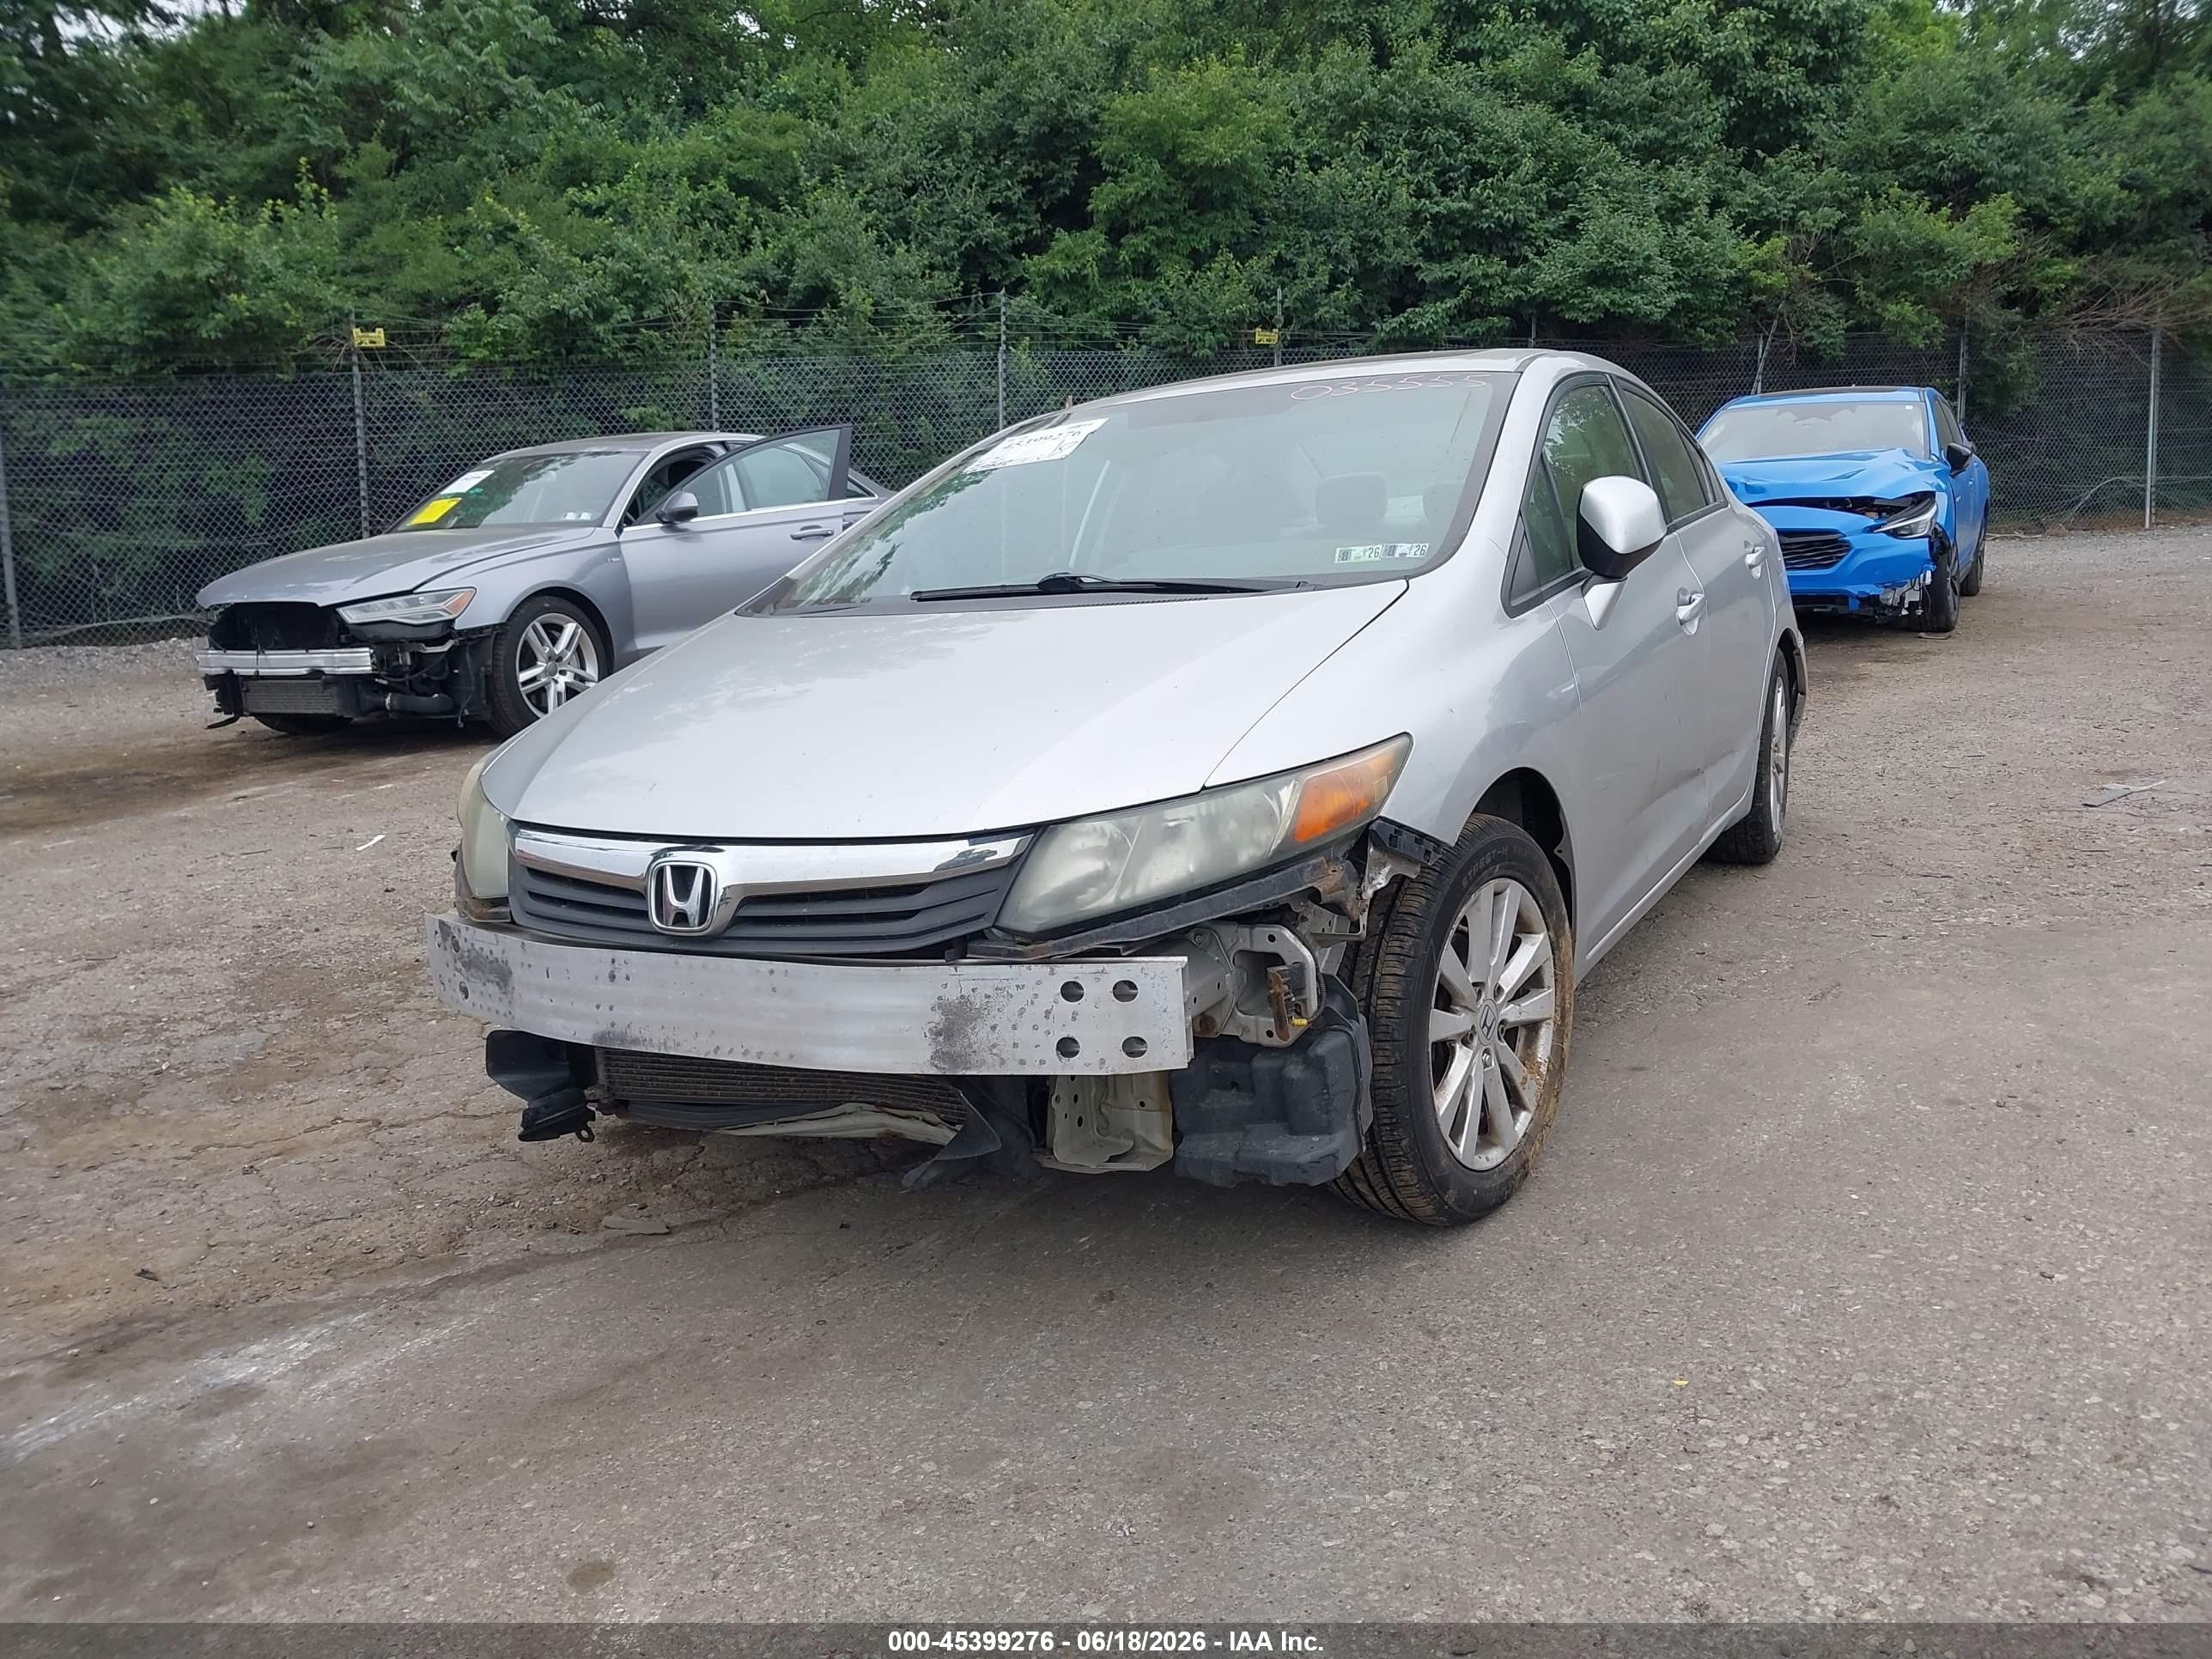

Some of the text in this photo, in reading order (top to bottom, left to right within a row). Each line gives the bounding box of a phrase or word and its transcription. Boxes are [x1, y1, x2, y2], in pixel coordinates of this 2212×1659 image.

[1291, 374, 1491, 400] 035555
[1368, 547, 1380, 558] 26
[1413, 544, 1427, 556] 26
